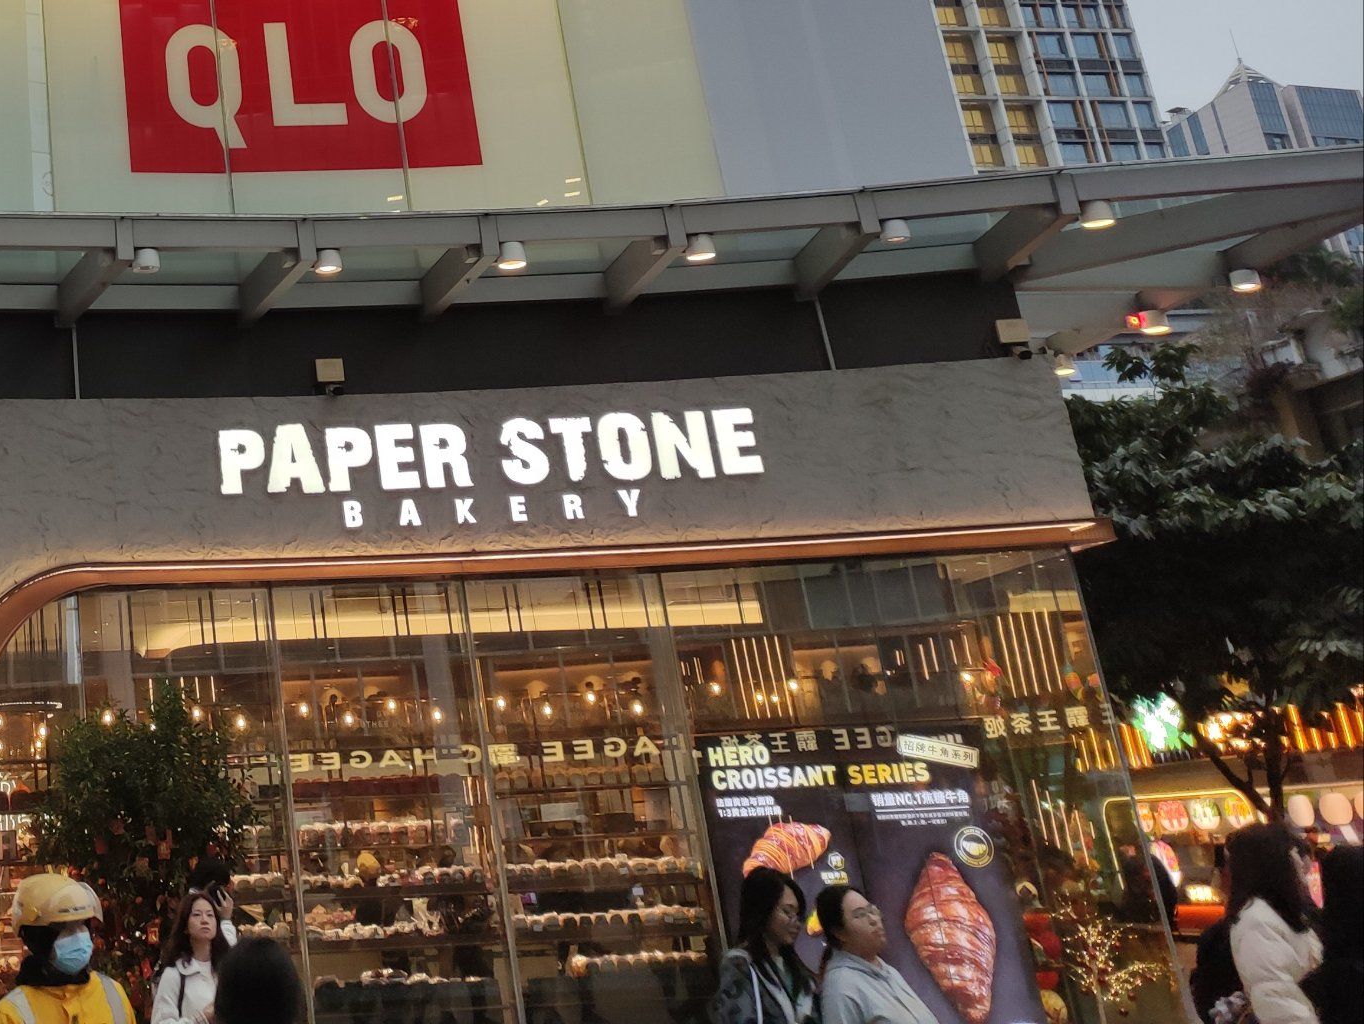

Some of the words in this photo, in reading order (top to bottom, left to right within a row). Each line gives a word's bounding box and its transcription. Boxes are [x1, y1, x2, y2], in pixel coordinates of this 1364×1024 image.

[164, 18, 428, 150] QLO
[216, 421, 475, 496] PAPER
[498, 407, 766, 486] STONE
[342, 487, 641, 529] BAKERY
[708, 744, 771, 767] HERO
[902, 739, 974, 763] 招牌牛角系列
[711, 764, 836, 791] CROISSANT
[847, 762, 931, 786] SERIES
